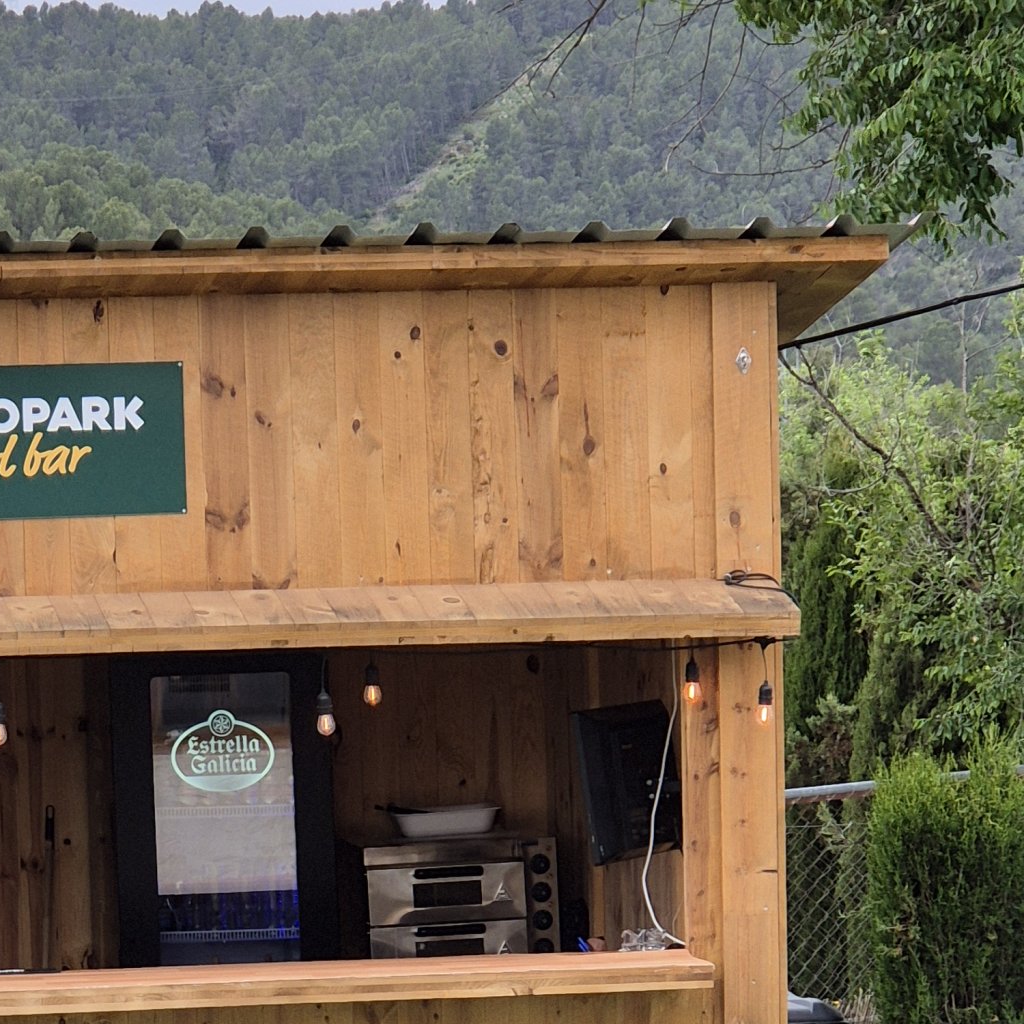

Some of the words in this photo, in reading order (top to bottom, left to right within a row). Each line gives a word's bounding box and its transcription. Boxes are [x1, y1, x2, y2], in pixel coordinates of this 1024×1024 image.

[23, 431, 93, 478] bar
[186, 735, 260, 754] Estrella
[190, 754, 257, 774] Galicia
